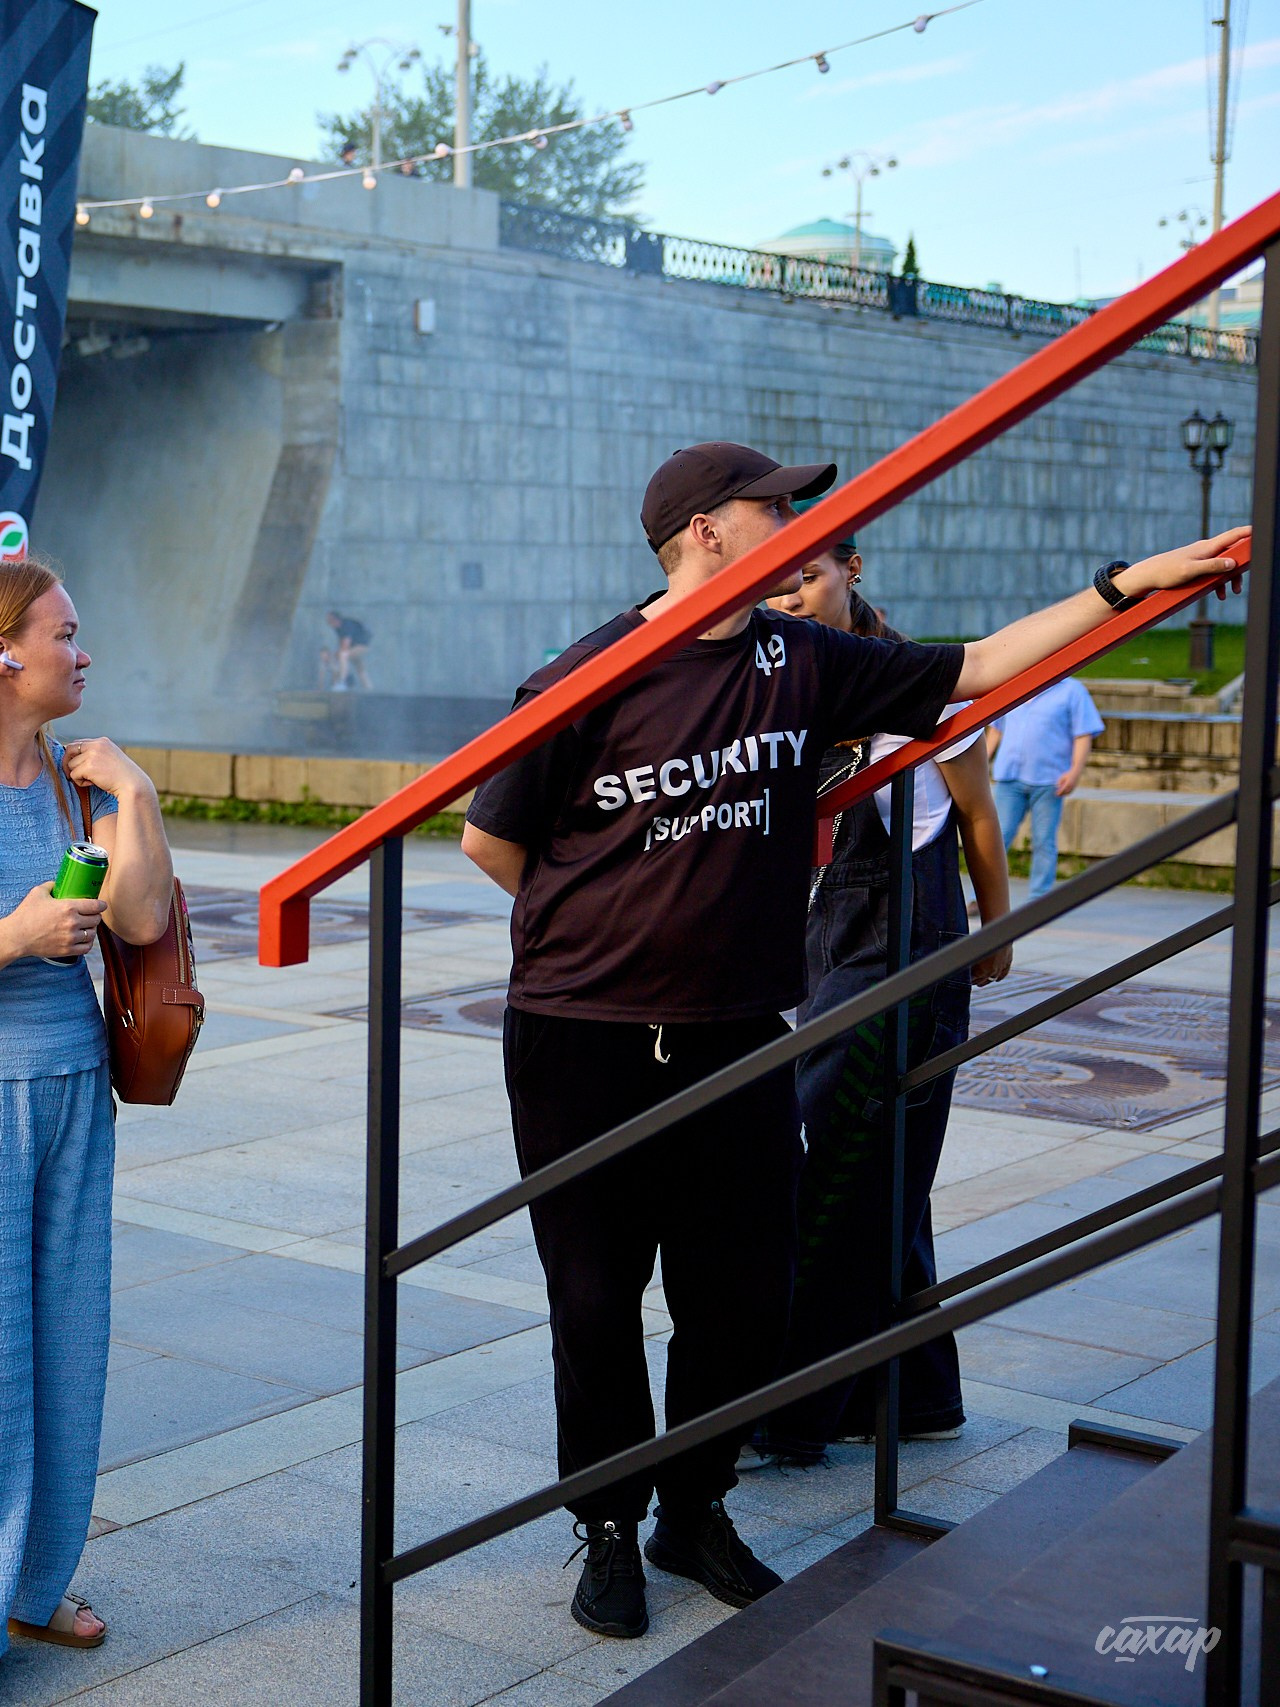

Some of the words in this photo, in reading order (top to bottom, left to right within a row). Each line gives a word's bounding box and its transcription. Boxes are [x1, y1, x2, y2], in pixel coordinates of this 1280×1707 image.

[1, 84, 48, 470] Доставка
[755, 634, 786, 676] 49
[593, 729, 808, 811] SECURITY
